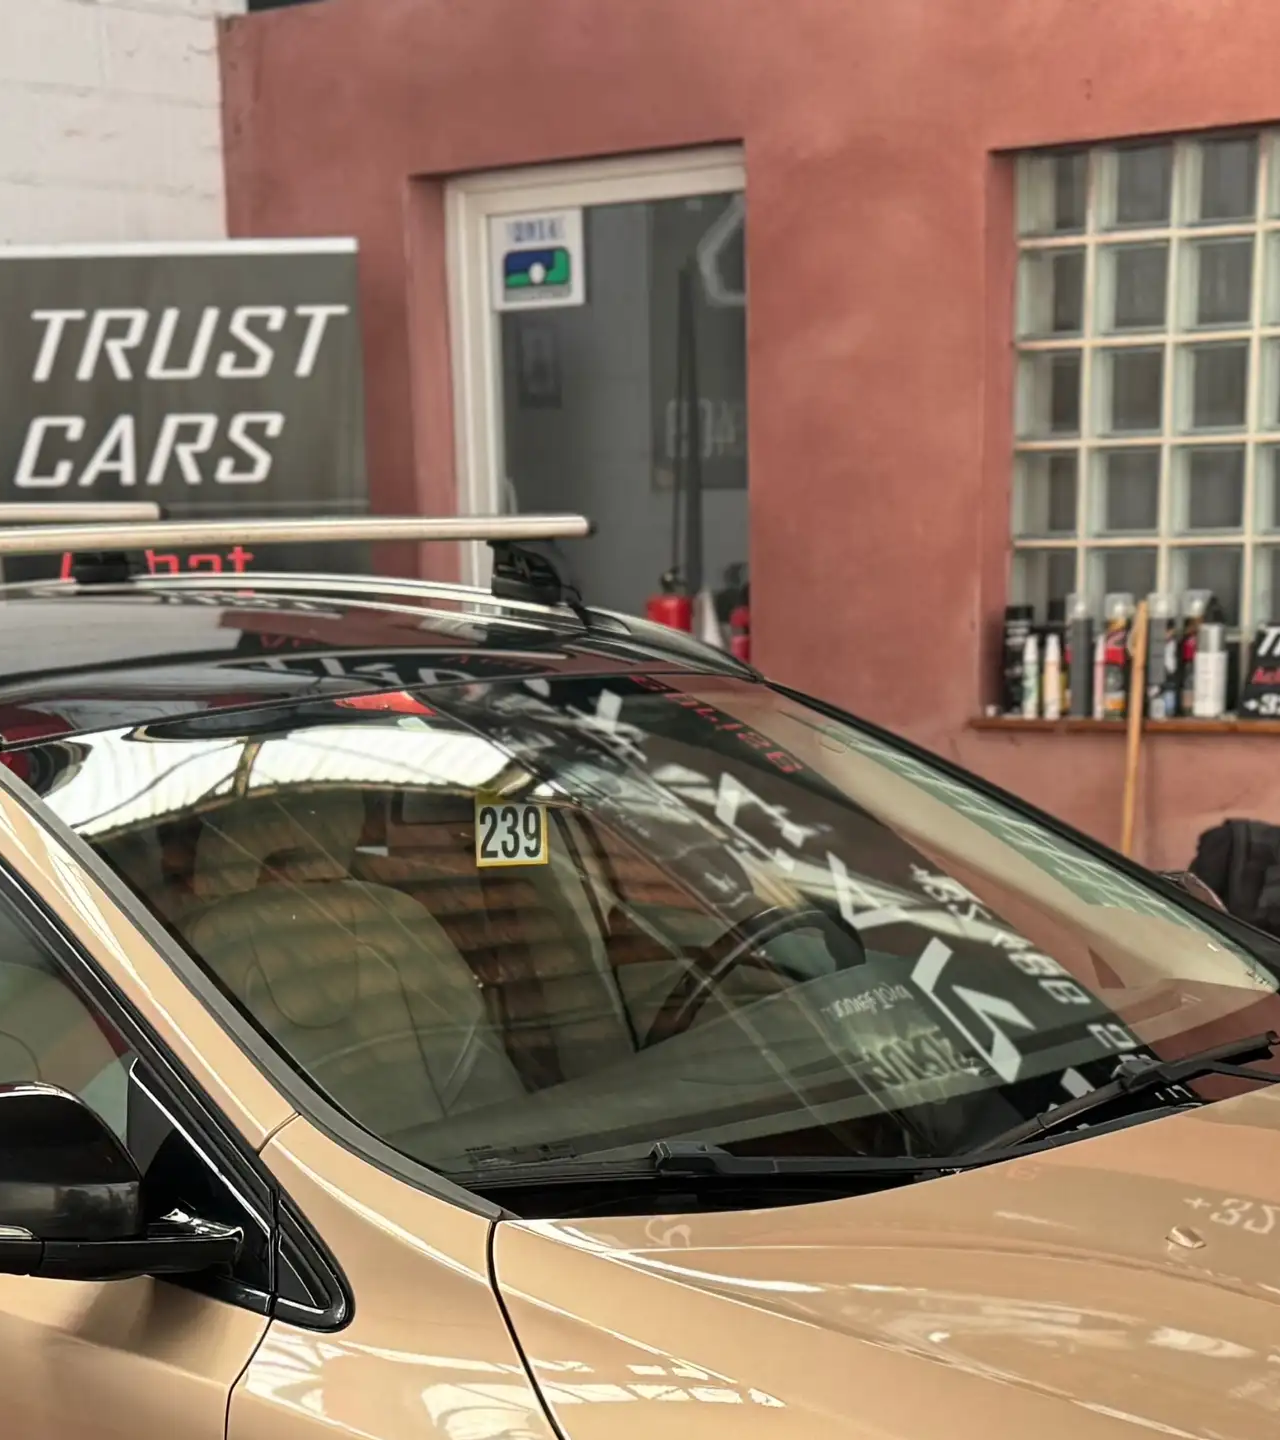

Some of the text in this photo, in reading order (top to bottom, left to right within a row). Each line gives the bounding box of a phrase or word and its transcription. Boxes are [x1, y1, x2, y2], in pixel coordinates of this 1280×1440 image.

[31, 303, 349, 382] TRUST
[14, 412, 284, 488] CARS
[479, 805, 542, 858] 239
